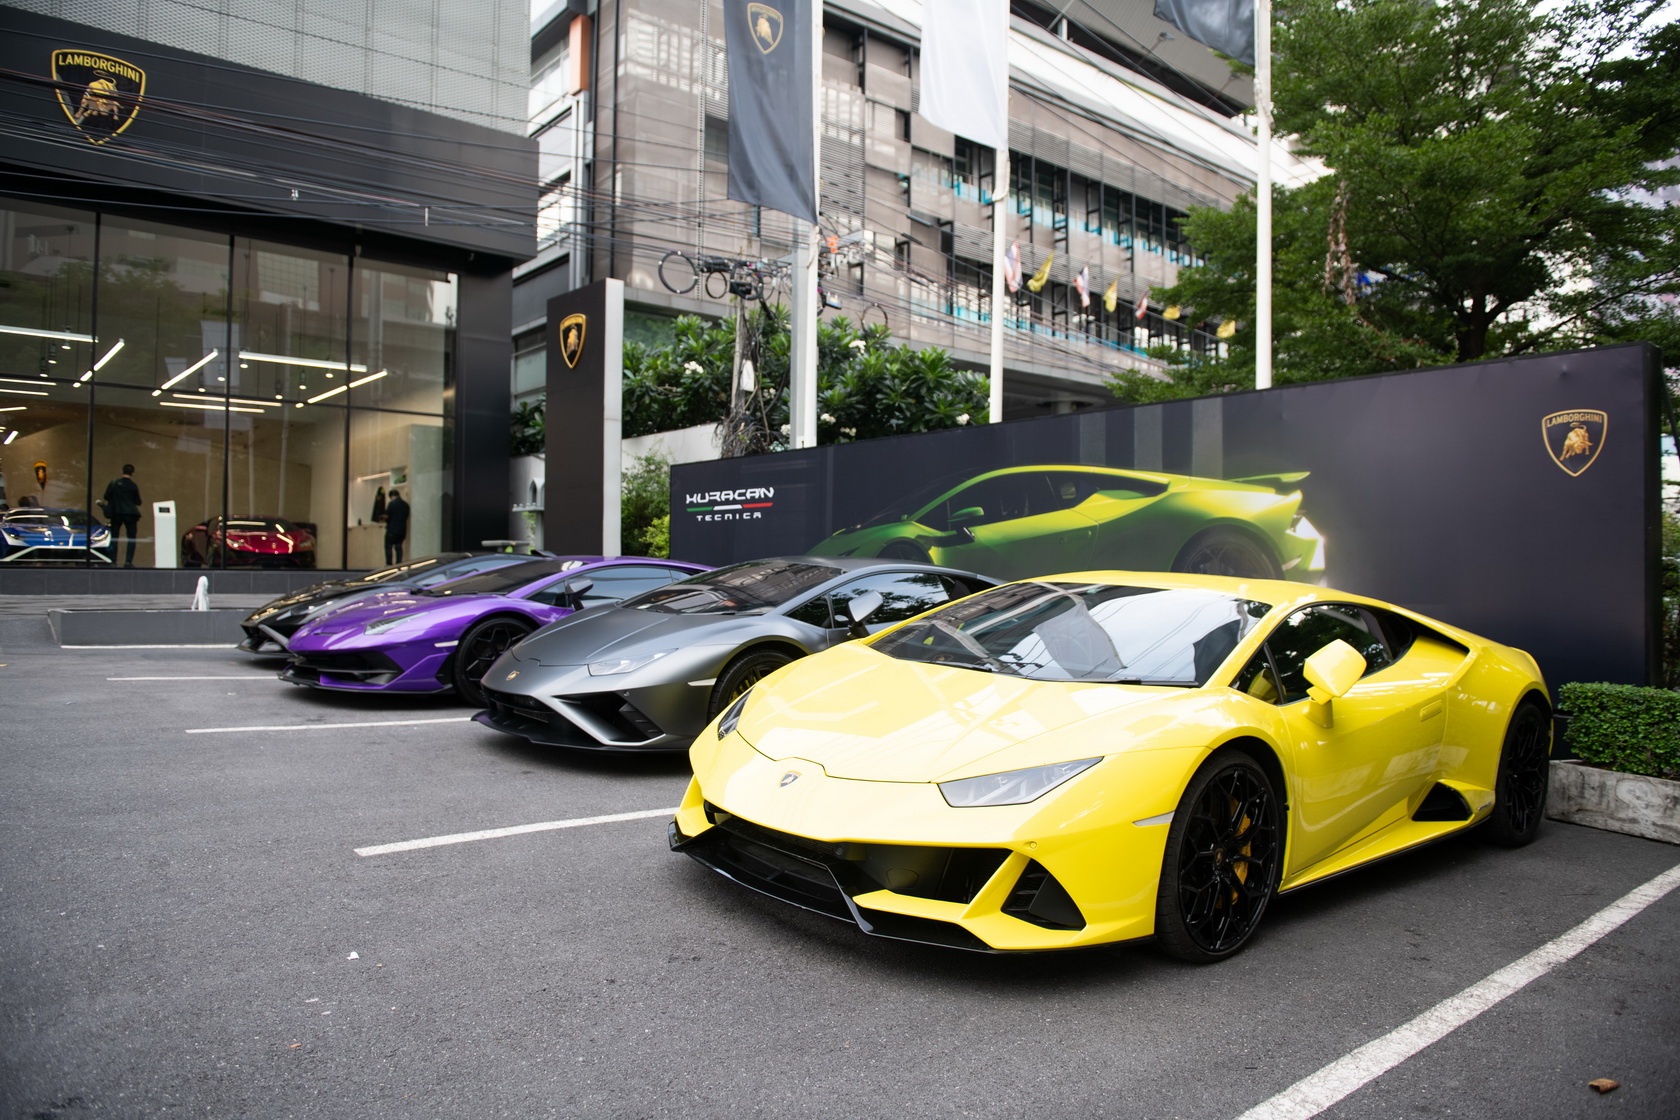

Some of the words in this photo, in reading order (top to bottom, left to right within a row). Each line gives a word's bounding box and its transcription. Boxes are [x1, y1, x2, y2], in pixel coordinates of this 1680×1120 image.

[58, 53, 140, 83] LAMBORGHINI
[1546, 412, 1603, 428] LAMBORGHINI
[696, 511, 762, 522] TECNICA
